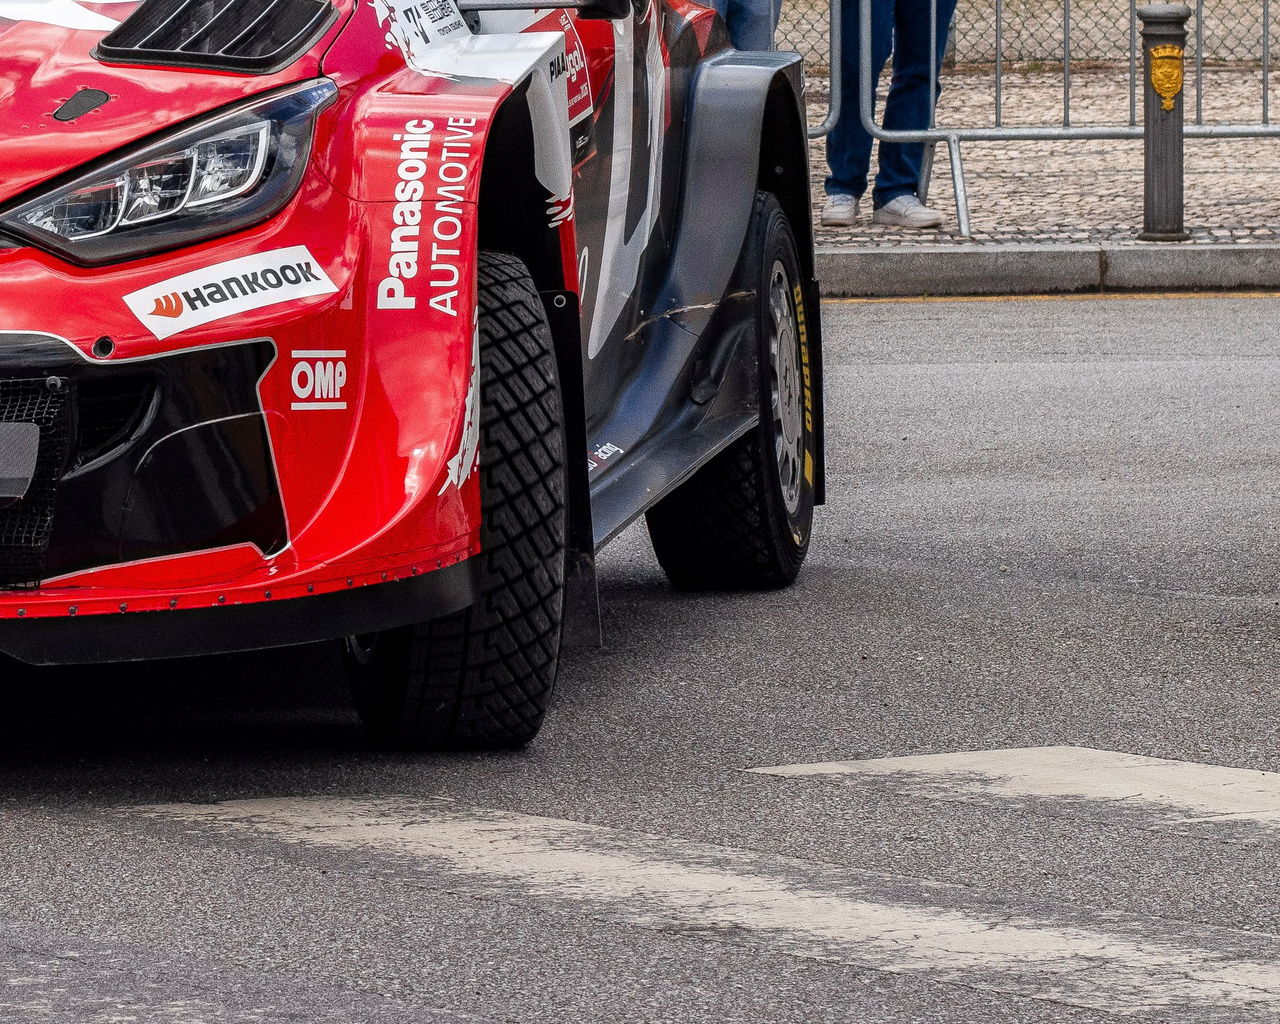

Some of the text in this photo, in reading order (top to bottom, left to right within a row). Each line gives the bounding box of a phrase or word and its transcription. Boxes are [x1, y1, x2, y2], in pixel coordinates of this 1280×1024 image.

[549, 52, 566, 83] PIAA
[376, 118, 435, 310] Panasonic
[428, 116, 477, 317] AUTOMOTIVE
[291, 360, 347, 399] OMP
